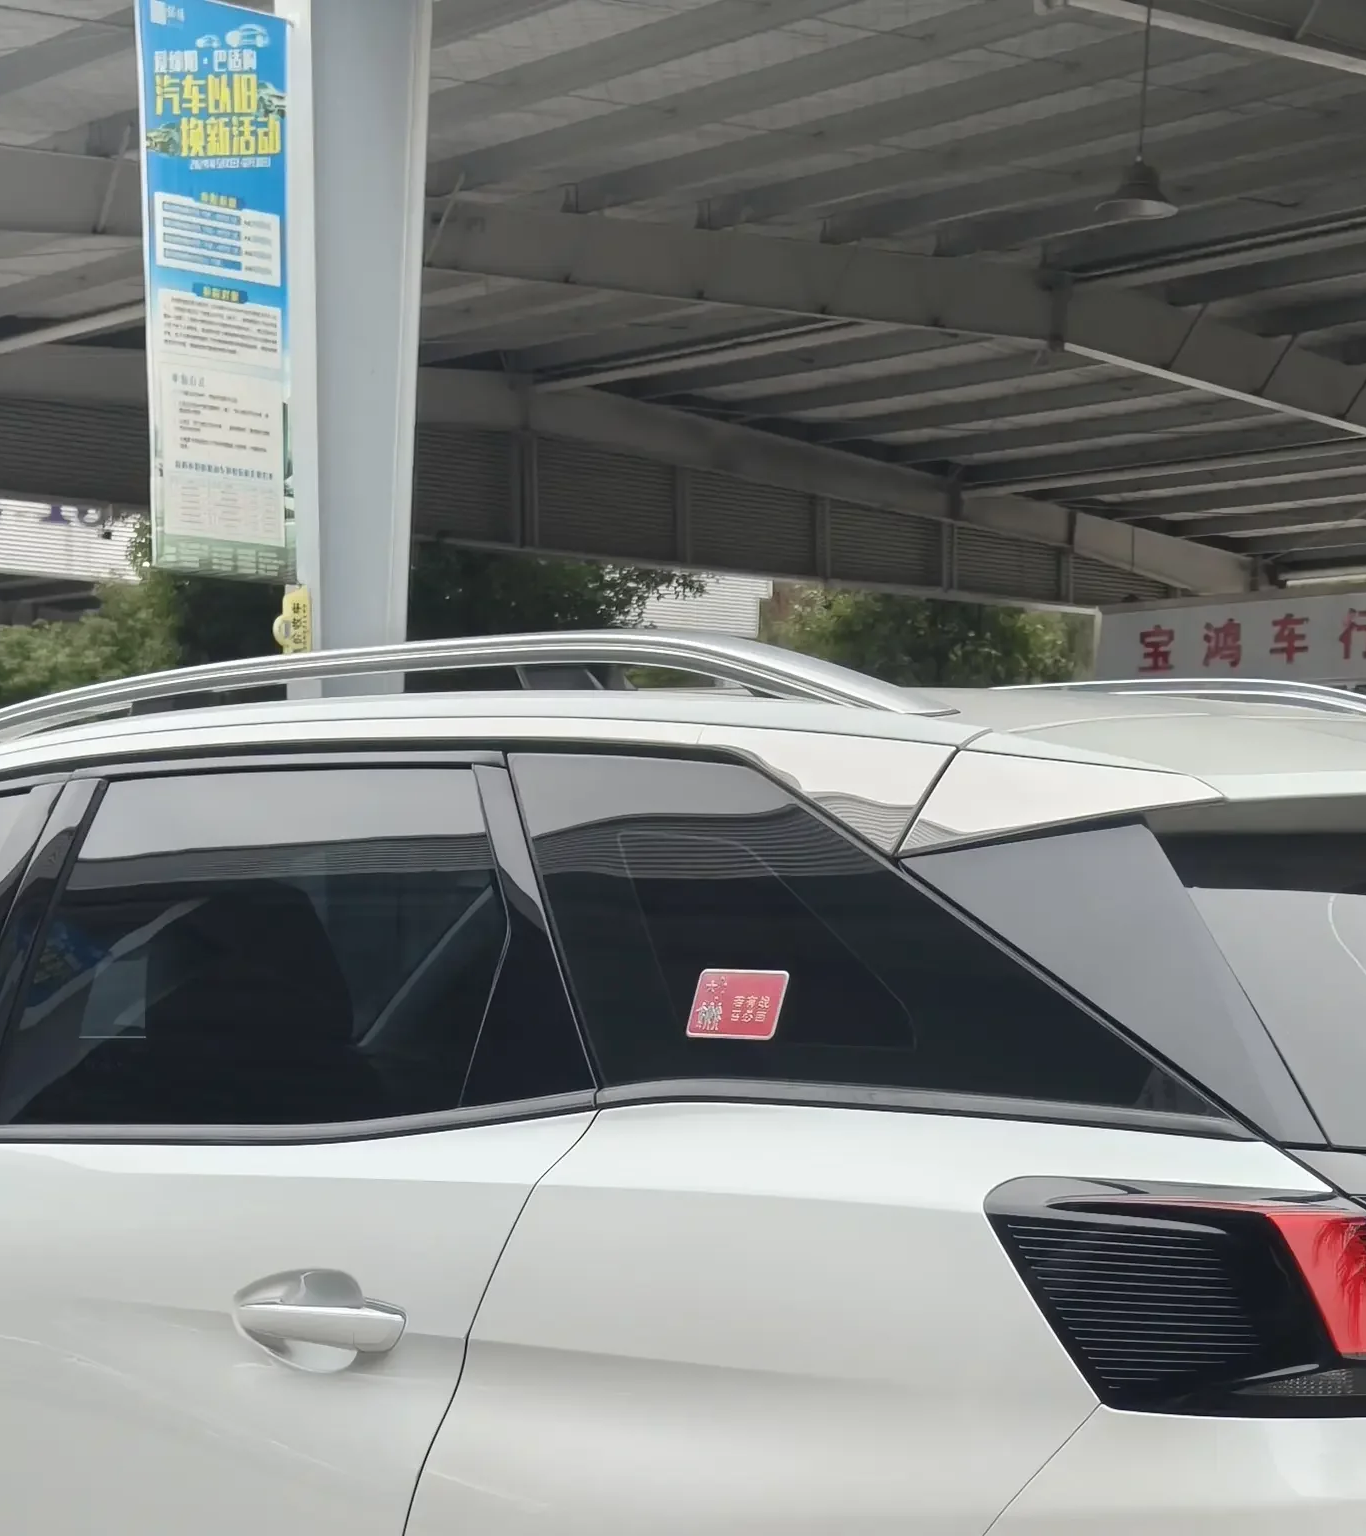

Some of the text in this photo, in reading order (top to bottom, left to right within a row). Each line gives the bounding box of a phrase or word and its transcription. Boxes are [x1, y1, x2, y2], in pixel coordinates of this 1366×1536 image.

[155, 74, 257, 116] 汽车以旧
[180, 114, 281, 157] 换新活动
